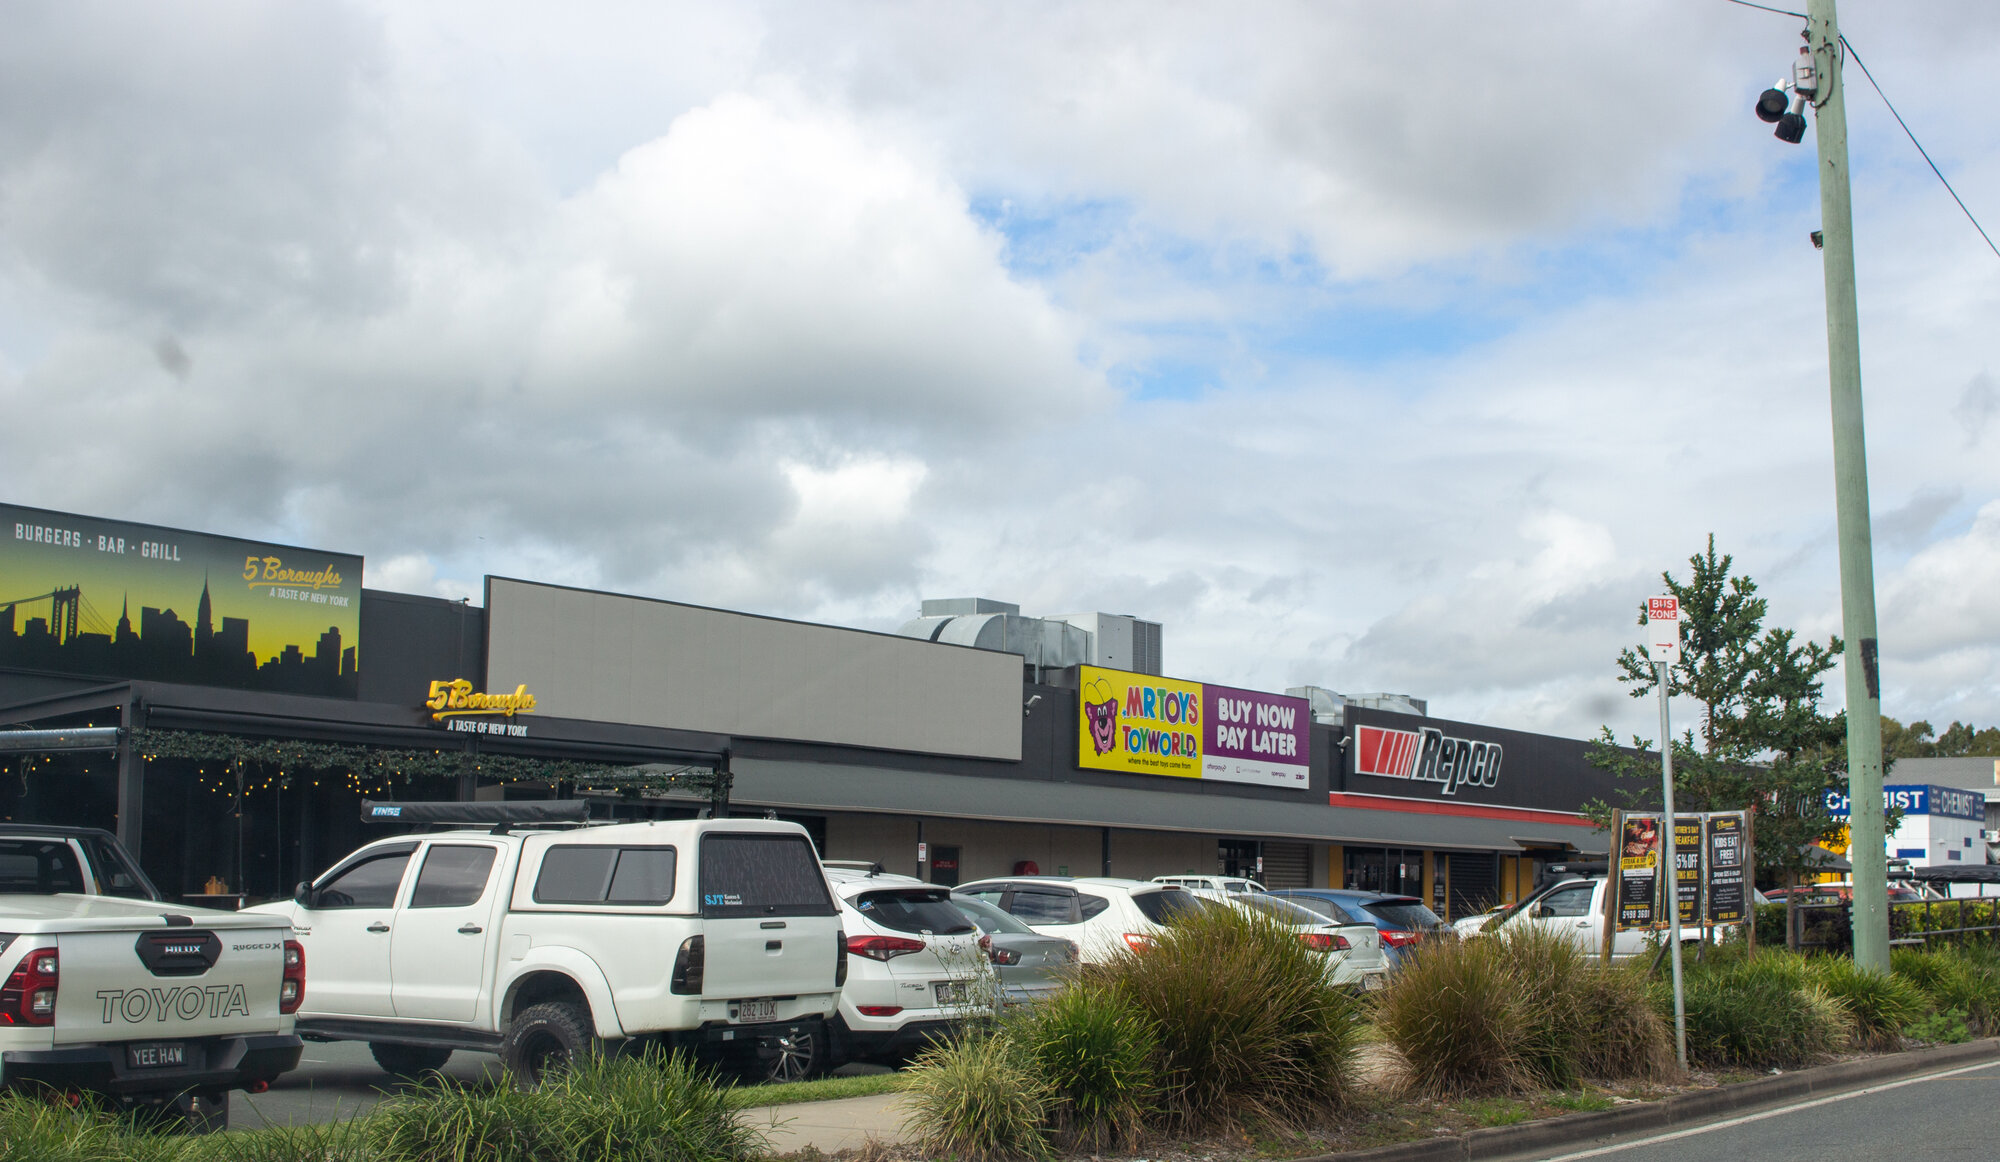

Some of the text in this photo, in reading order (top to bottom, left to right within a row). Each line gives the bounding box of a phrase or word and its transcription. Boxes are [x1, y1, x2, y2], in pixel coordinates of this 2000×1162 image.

[15, 523, 181, 562] BURGERS BAR GRILL
[242, 555, 343, 590] 5 Boroughs
[269, 587, 350, 607] A TASTE OF NEW YORK
[1652, 599, 1674, 609] BUS
[1650, 609, 1677, 619] ZONE
[426, 678, 537, 717] 5 Boroughs
[1126, 686, 1198, 726] MR TOYS
[1218, 697, 1295, 730] BUY NOW
[447, 720, 528, 737] A TASTE OF NEW YORK
[1122, 724, 1197, 758] TOYWORLD
[1217, 725, 1296, 757] PAY LATER
[1150, 759, 1159, 767] best
[1159, 760, 1169, 768] toys
[1411, 726, 1502, 795] Repco
[1825, 789, 1924, 809] CHIST
[1942, 791, 1974, 816] CHEMIST
[371, 806, 401, 816] KINGS
[1675, 825, 1690, 834] OTHER'S
[1675, 835, 1699, 845] REAKFAST
[1714, 836, 1738, 848] KIDS EAT
[1677, 853, 1698, 869] 5% OFF
[704, 894, 724, 905] SJT
[164, 945, 201, 953] HILUX
[96, 984, 249, 1024] TOYOTA
[133, 1047, 183, 1066] YEE H4W
